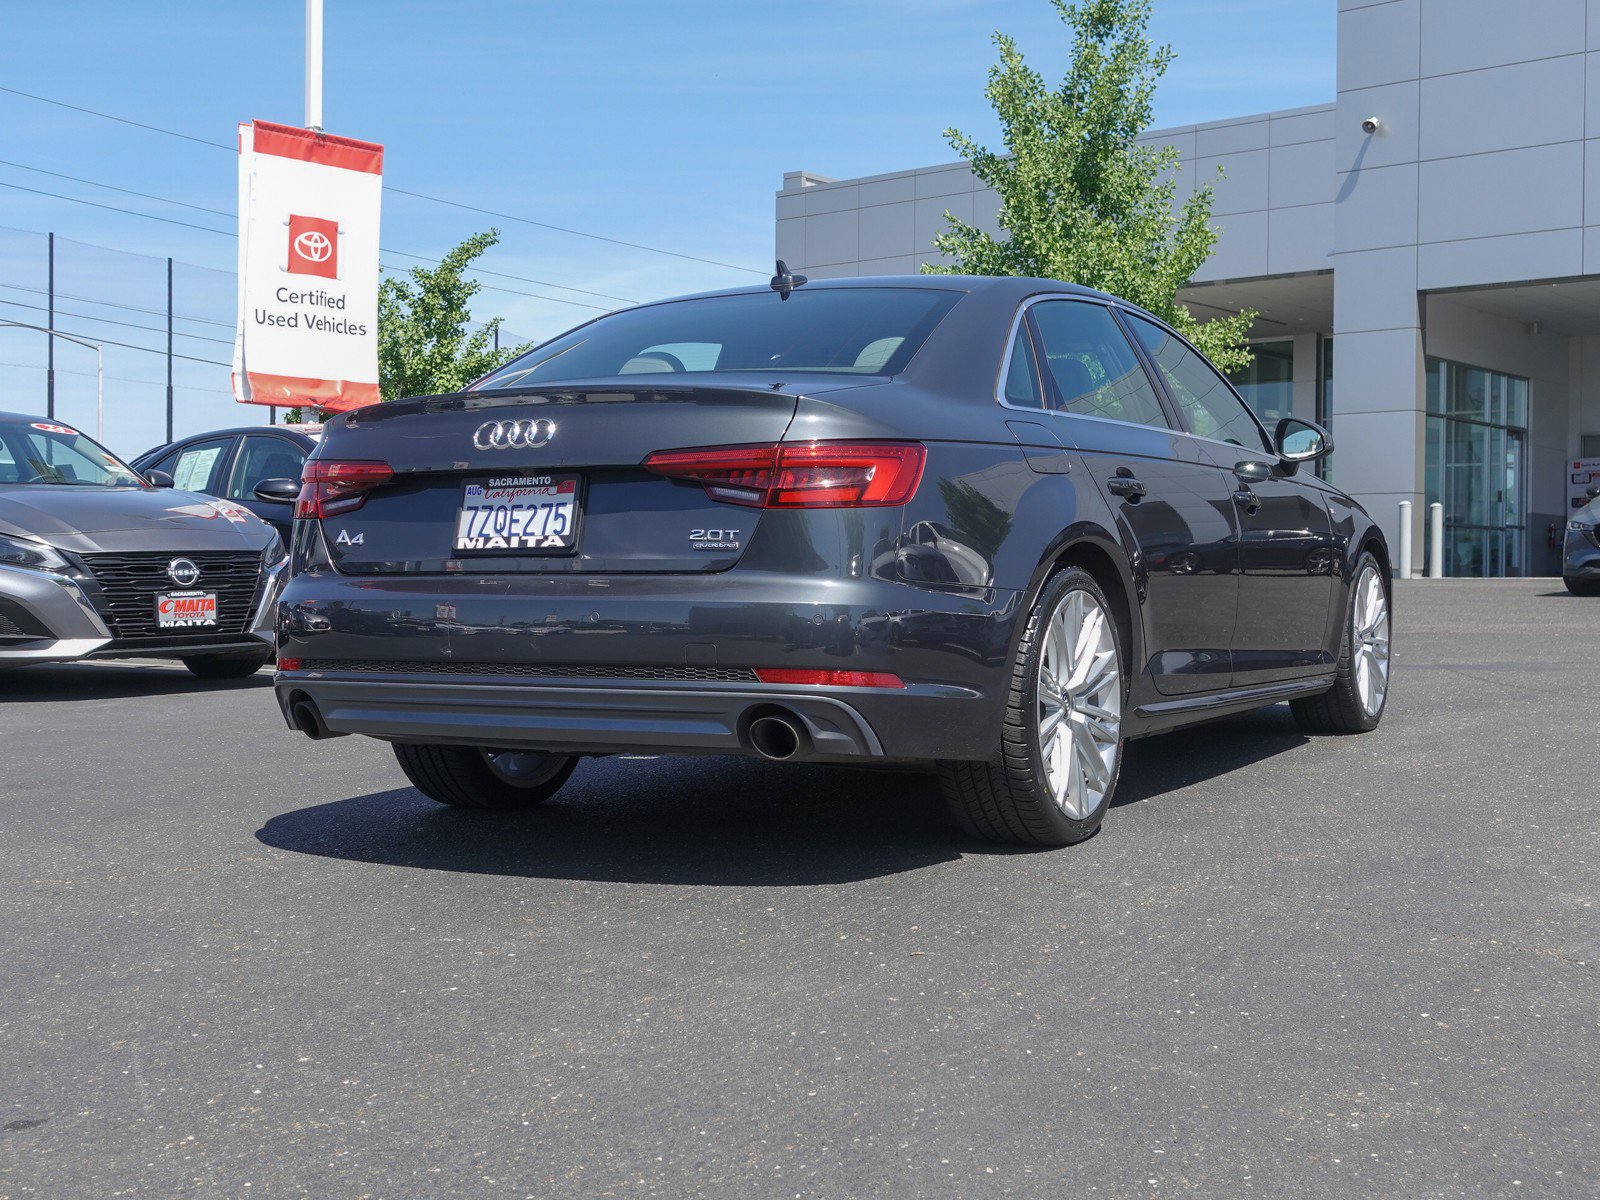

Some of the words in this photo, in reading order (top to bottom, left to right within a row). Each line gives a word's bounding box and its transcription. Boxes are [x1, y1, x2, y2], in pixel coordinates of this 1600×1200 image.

[276, 287, 346, 310] Certified
[255, 309, 298, 328] Used
[304, 313, 367, 336] Vehicles
[488, 476, 551, 487] SACRAMENTO
[467, 487, 482, 496] AUG
[484, 486, 557, 503] California
[466, 503, 568, 538] 7ZQE275
[335, 529, 364, 546] A4
[457, 535, 565, 549] MAITA
[689, 529, 740, 541] 2.0T
[160, 619, 216, 628] MAITA
